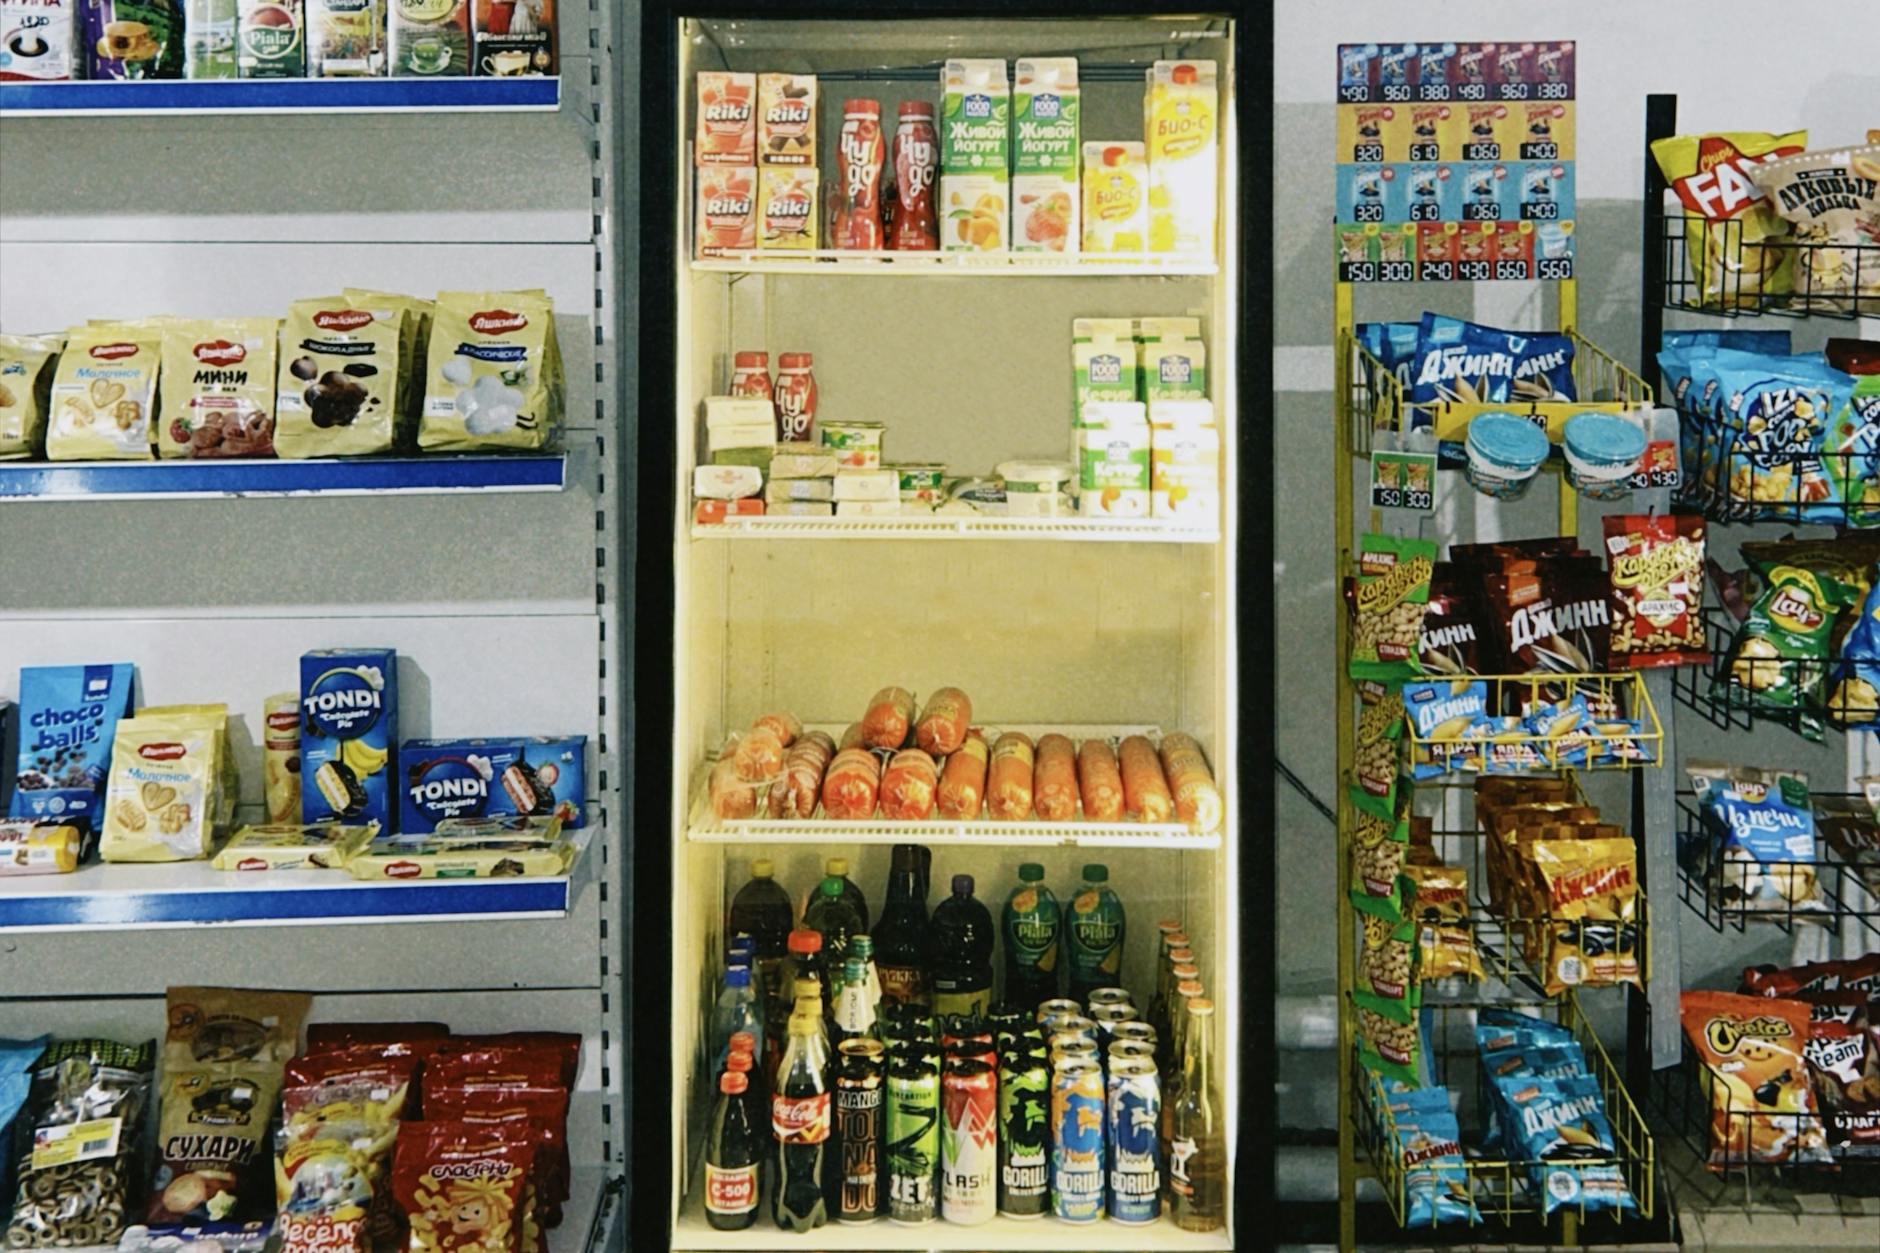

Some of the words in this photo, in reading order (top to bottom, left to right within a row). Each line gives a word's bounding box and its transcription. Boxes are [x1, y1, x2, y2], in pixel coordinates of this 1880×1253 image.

[1341, 86, 1368, 101] 490
[1384, 85, 1411, 100] 960
[1420, 84, 1449, 99] 1380
[1458, 85, 1485, 99] 490
[1501, 84, 1528, 98] 960
[1538, 83, 1568, 98] 1380
[706, 104, 748, 121] Riki
[766, 105, 808, 122] Riki
[1357, 146, 1382, 161] 320
[1470, 144, 1499, 159] 1060
[1527, 144, 1556, 159] 1400
[1701, 146, 1734, 172] Chips
[1778, 176, 1877, 211] ЛУКОВЫЕ
[707, 199, 749, 216] Riki
[767, 200, 809, 216] Riki
[1357, 205, 1382, 221] 320
[1527, 203, 1556, 218] 1400
[1348, 263, 1374, 280] 150
[1380, 263, 1411, 279] 300
[1422, 262, 1452, 279] 240
[1459, 262, 1490, 278] 430
[1496, 261, 1527, 278] 660
[1540, 261, 1570, 278] 560
[193, 370, 248, 384] МИНИ
[1652, 471, 1677, 486] 430
[1380, 490, 1399, 505] 150
[1406, 490, 1430, 508] 300
[303, 689, 381, 715] TONDI
[30, 703, 104, 727] choco
[37, 724, 98, 751] balls
[410, 777, 488, 804] TONDI
[1707, 1017, 1794, 1055] Cheetos
[1816, 1044, 1861, 1069] team
[165, 1136, 258, 1162] СУХАРИ
[711, 1182, 751, 1198] C-500
[889, 1174, 930, 1204] ZET
[1110, 1171, 1161, 1194] GORILLA
